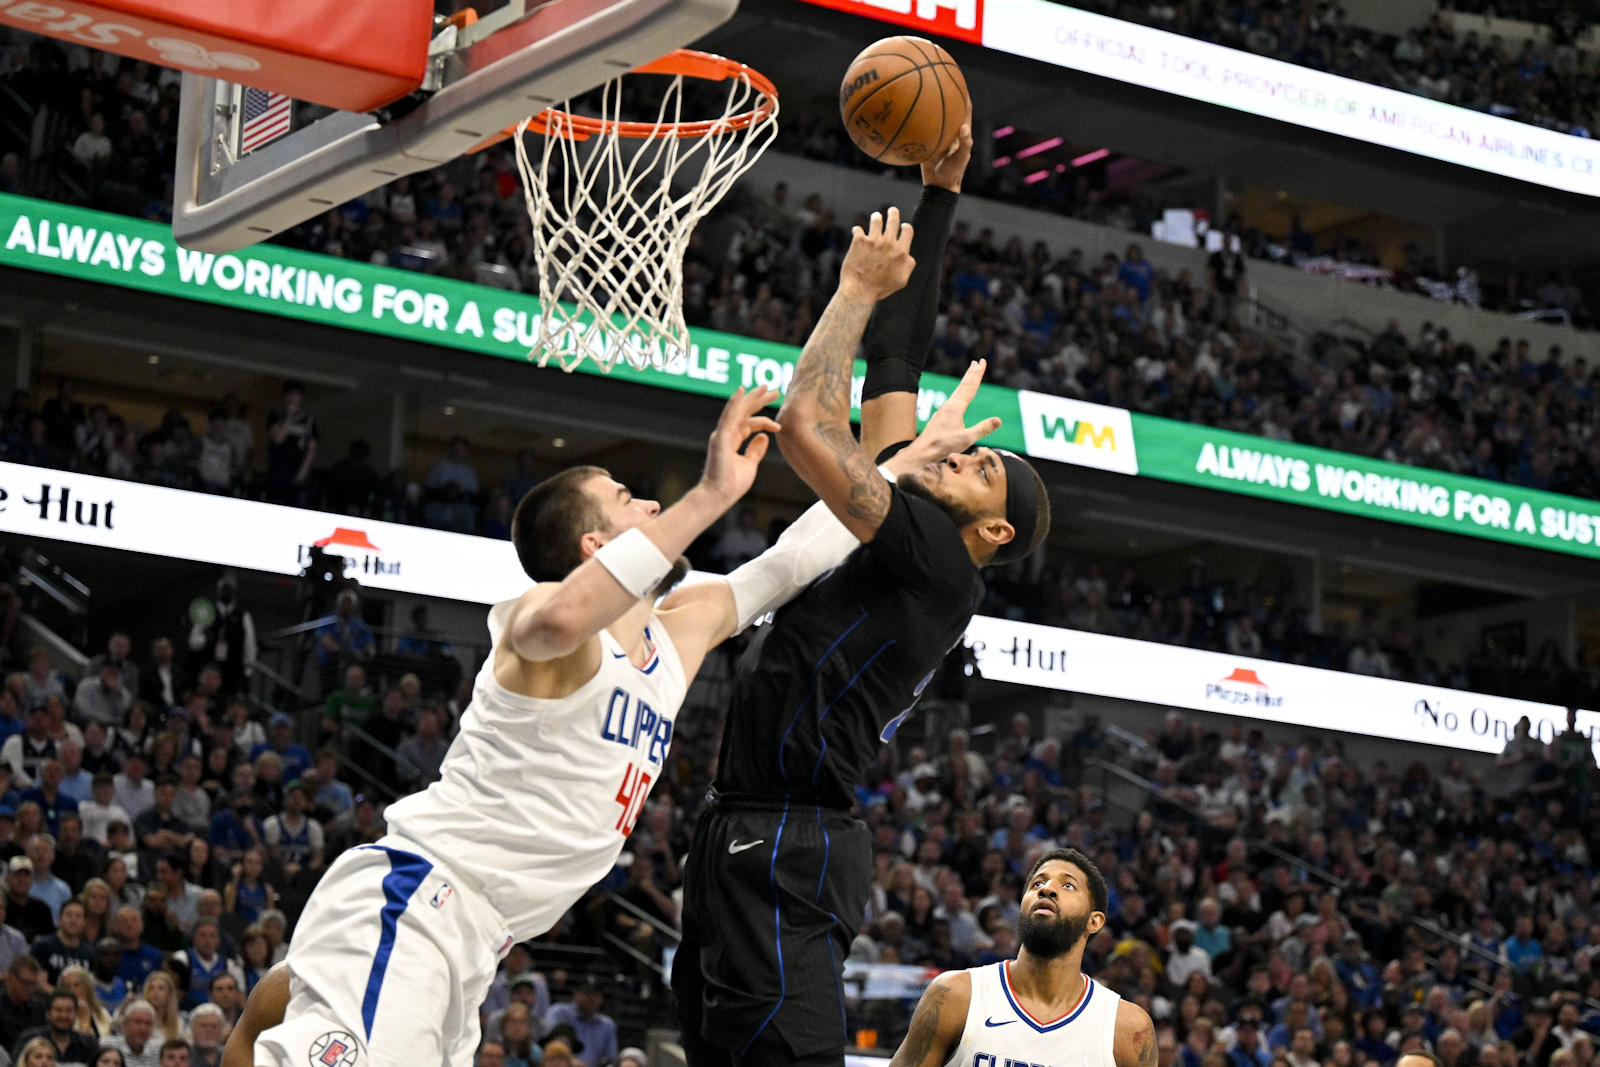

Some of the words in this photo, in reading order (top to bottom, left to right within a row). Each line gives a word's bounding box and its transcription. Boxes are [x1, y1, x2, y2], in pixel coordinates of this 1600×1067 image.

[0, 0, 143, 44] Sta
[1054, 26, 1147, 65] OFFICIAL
[1161, 51, 1212, 82] TOOL
[1222, 67, 1327, 109] PROVIDER
[1333, 97, 1357, 116] OF
[1369, 106, 1472, 146] AMERICAN
[1478, 134, 1563, 169] AIRLINES
[5, 215, 166, 276] ALWAYS
[176, 247, 363, 314] WORKING
[371, 283, 449, 331] FOR
[454, 301, 484, 339] A
[1041, 413, 1116, 452] WM
[22, 483, 116, 530] Hut
[1195, 442, 1311, 492] ALWAYS
[1315, 463, 1450, 517] WORKING
[1454, 490, 1511, 530] FOR
[1514, 501, 1537, 535] A
[1000, 635, 1067, 674] Hut
[1414, 699, 1459, 732] No
[1470, 707, 1508, 740] On
[615, 761, 652, 839] 40
